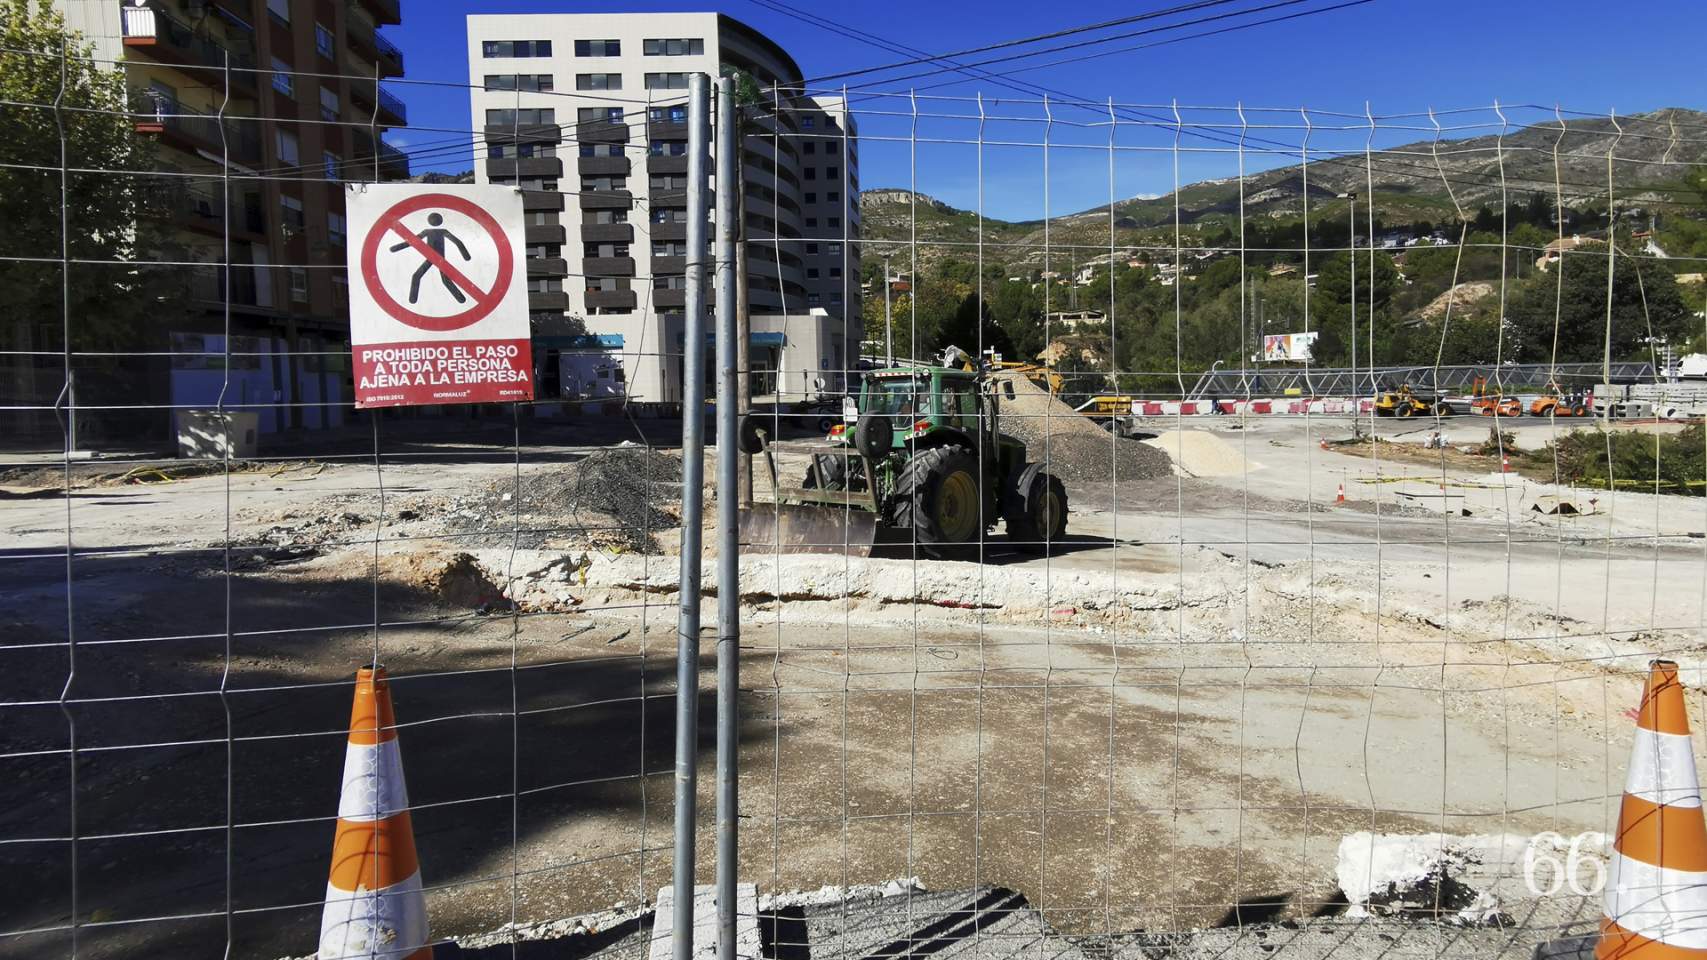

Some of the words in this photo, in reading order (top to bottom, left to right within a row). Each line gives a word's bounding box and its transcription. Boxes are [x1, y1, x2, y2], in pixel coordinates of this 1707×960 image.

[362, 346, 448, 363] PROHIBIDO
[453, 346, 472, 359] EL
[476, 344, 518, 358] PASO
[374, 362, 386, 375] A
[389, 360, 433, 374] TODA
[437, 358, 512, 372] PERSONA
[360, 374, 411, 389] AJENA
[414, 373, 426, 386] A
[430, 372, 450, 385] LA
[455, 369, 528, 384] EMPRESA
